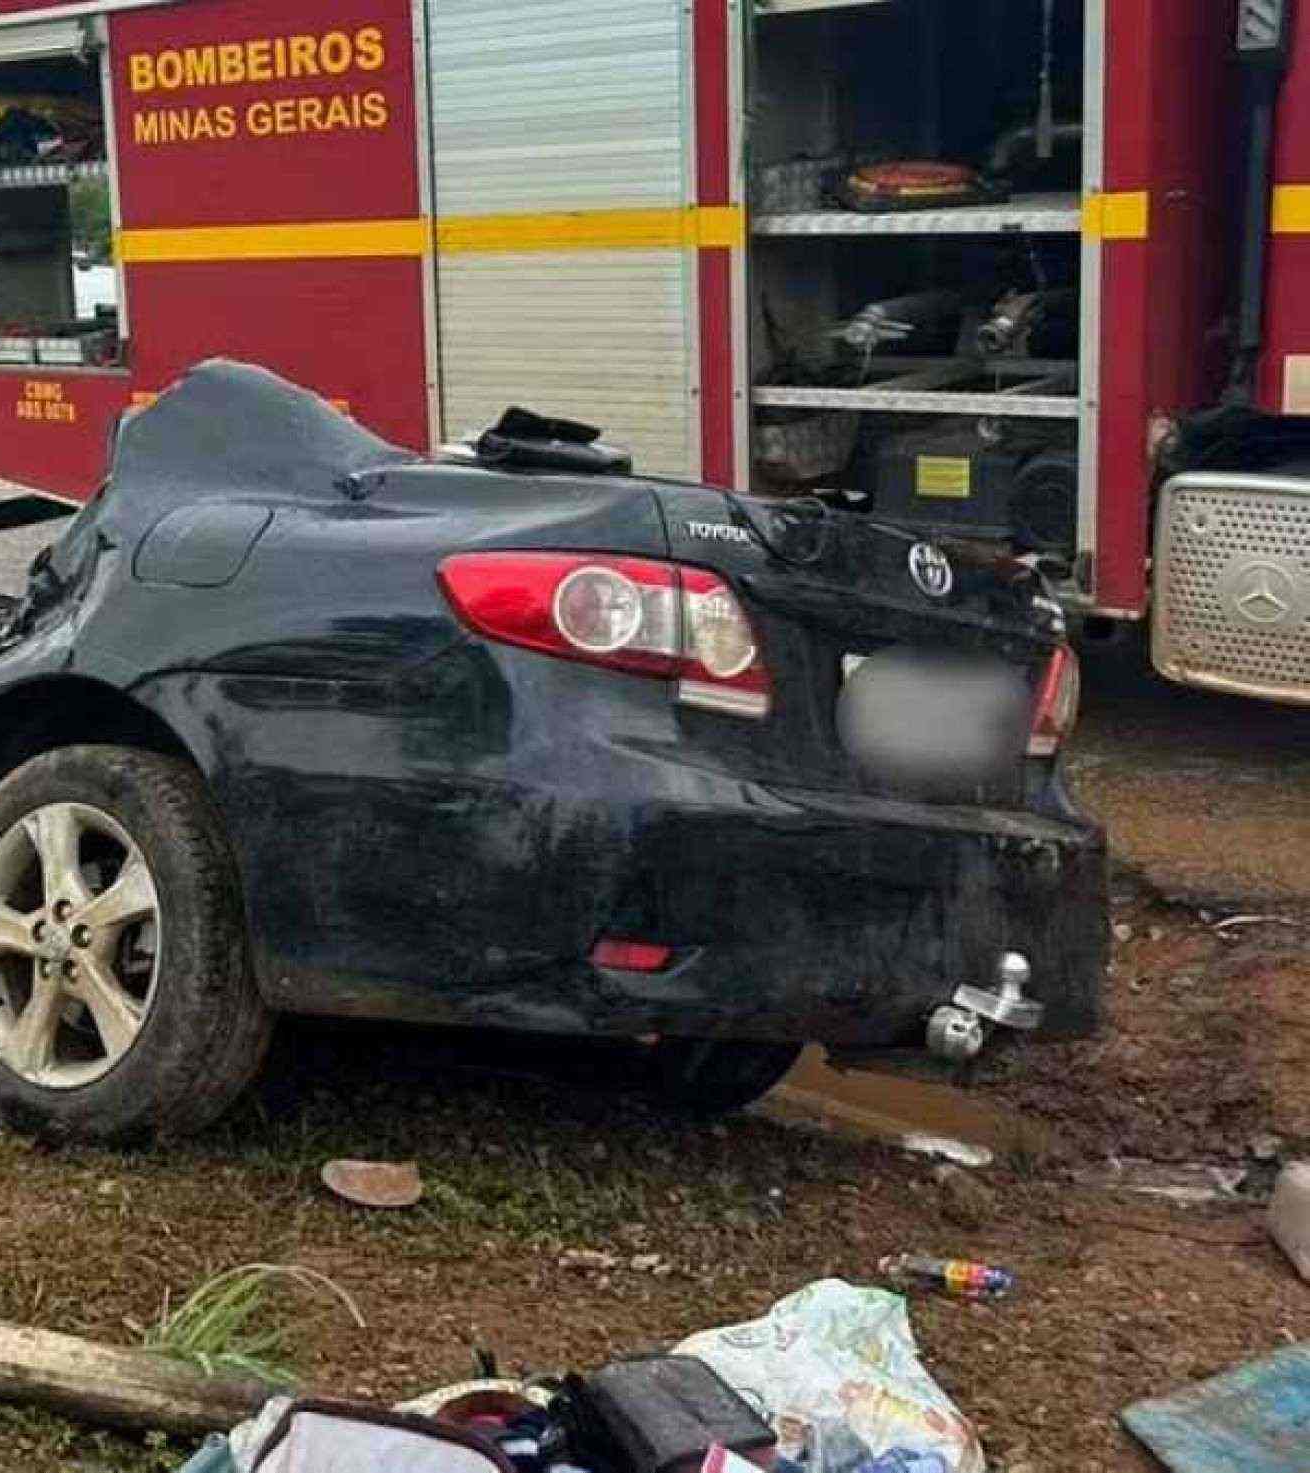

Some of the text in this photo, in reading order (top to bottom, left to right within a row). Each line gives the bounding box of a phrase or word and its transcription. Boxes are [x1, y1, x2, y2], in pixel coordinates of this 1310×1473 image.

[129, 27, 386, 93] BOMBEIROS
[133, 92, 389, 144] MINAS GERAIS
[685, 520, 752, 544] TOYOTA
